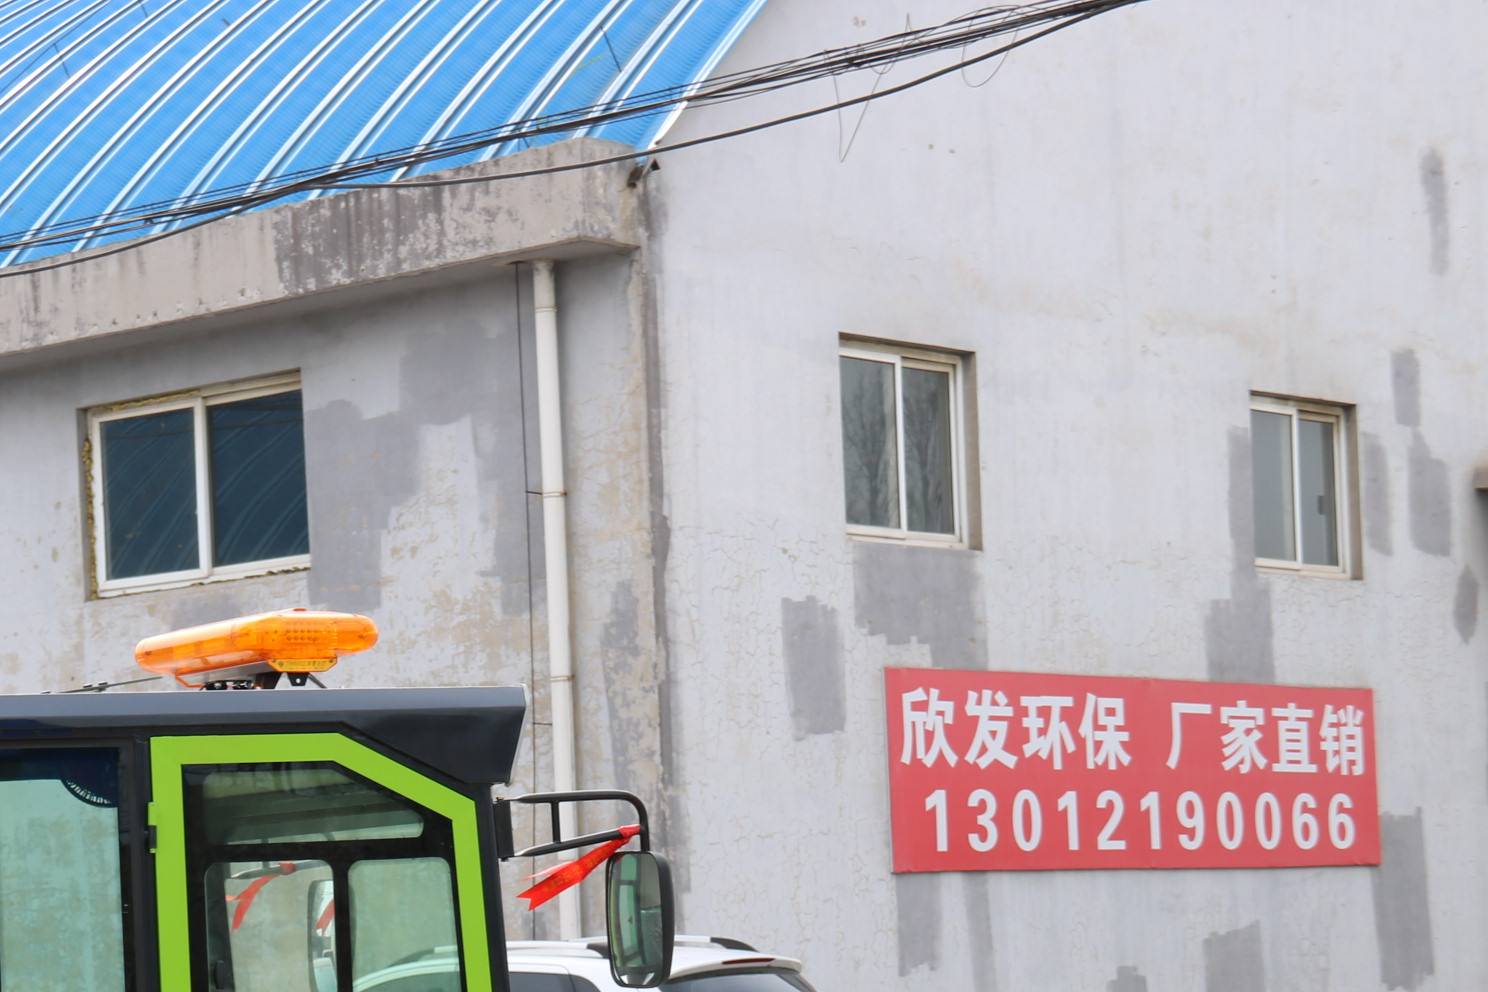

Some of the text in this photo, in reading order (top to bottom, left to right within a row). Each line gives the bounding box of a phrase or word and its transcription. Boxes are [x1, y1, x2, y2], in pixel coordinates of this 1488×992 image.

[900, 686, 1365, 776] 欣发环保 厂家直销
[924, 788, 1356, 852] 13012190066
